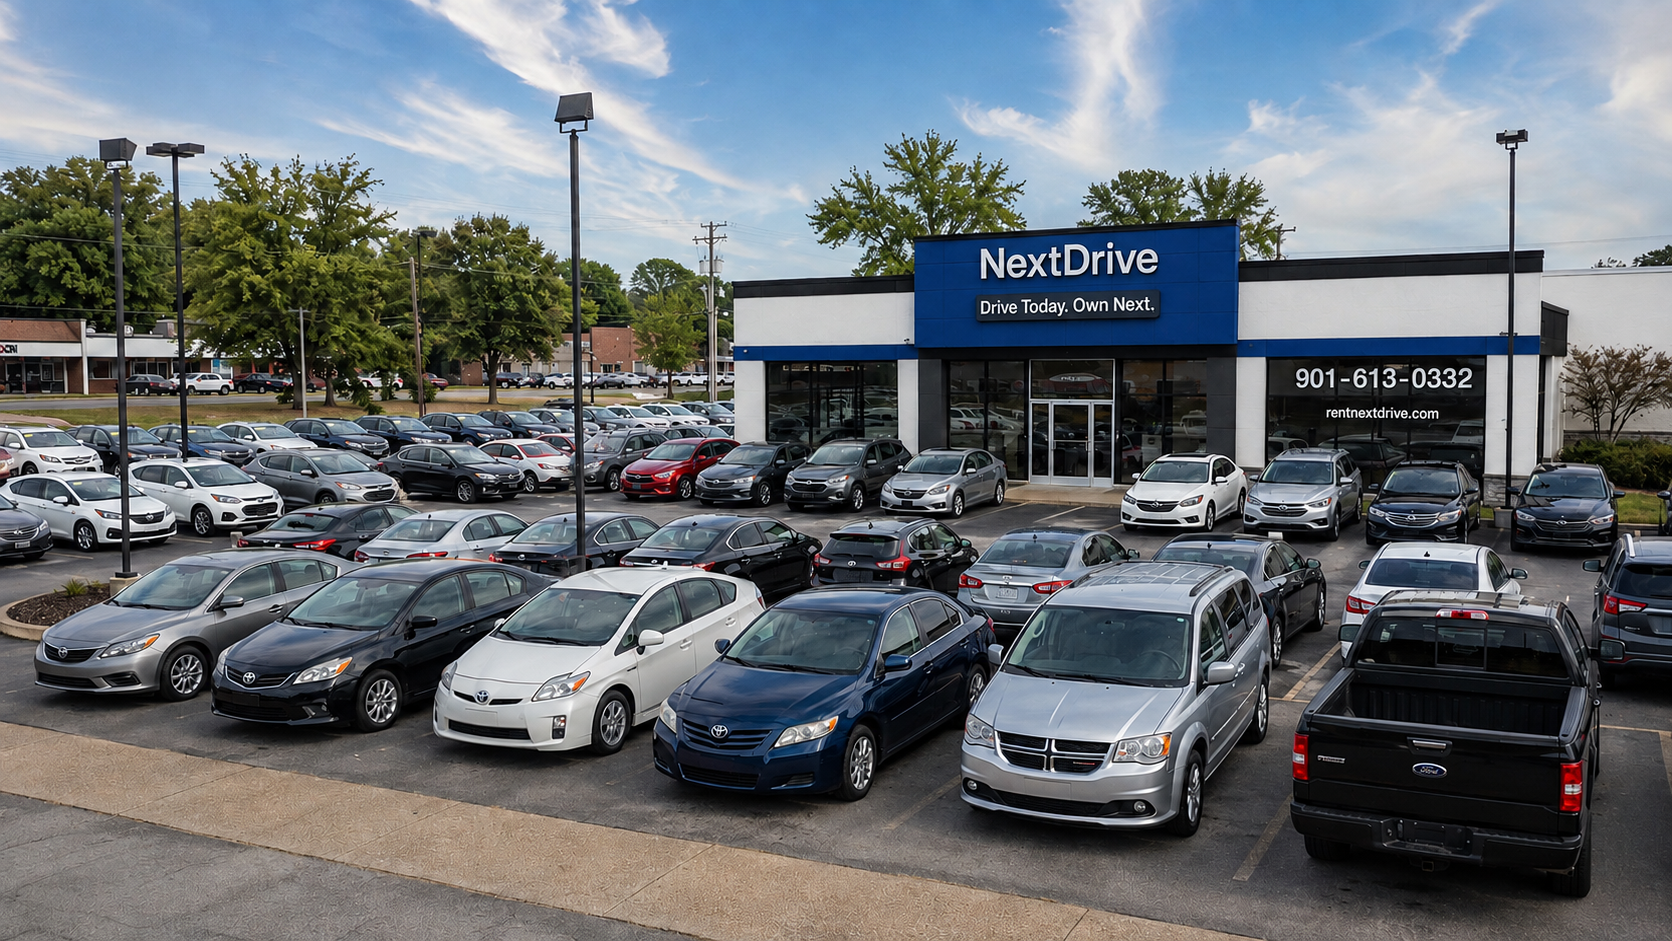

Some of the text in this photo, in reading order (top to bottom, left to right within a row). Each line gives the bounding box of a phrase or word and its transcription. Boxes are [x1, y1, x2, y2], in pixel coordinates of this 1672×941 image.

[980, 241, 1159, 280] NextDrive
[980, 296, 1155, 317] Drive Today. Own Next.
[1295, 367, 1473, 389] 901-613-0332
[1326, 406, 1439, 420] rentnextdrive.com
